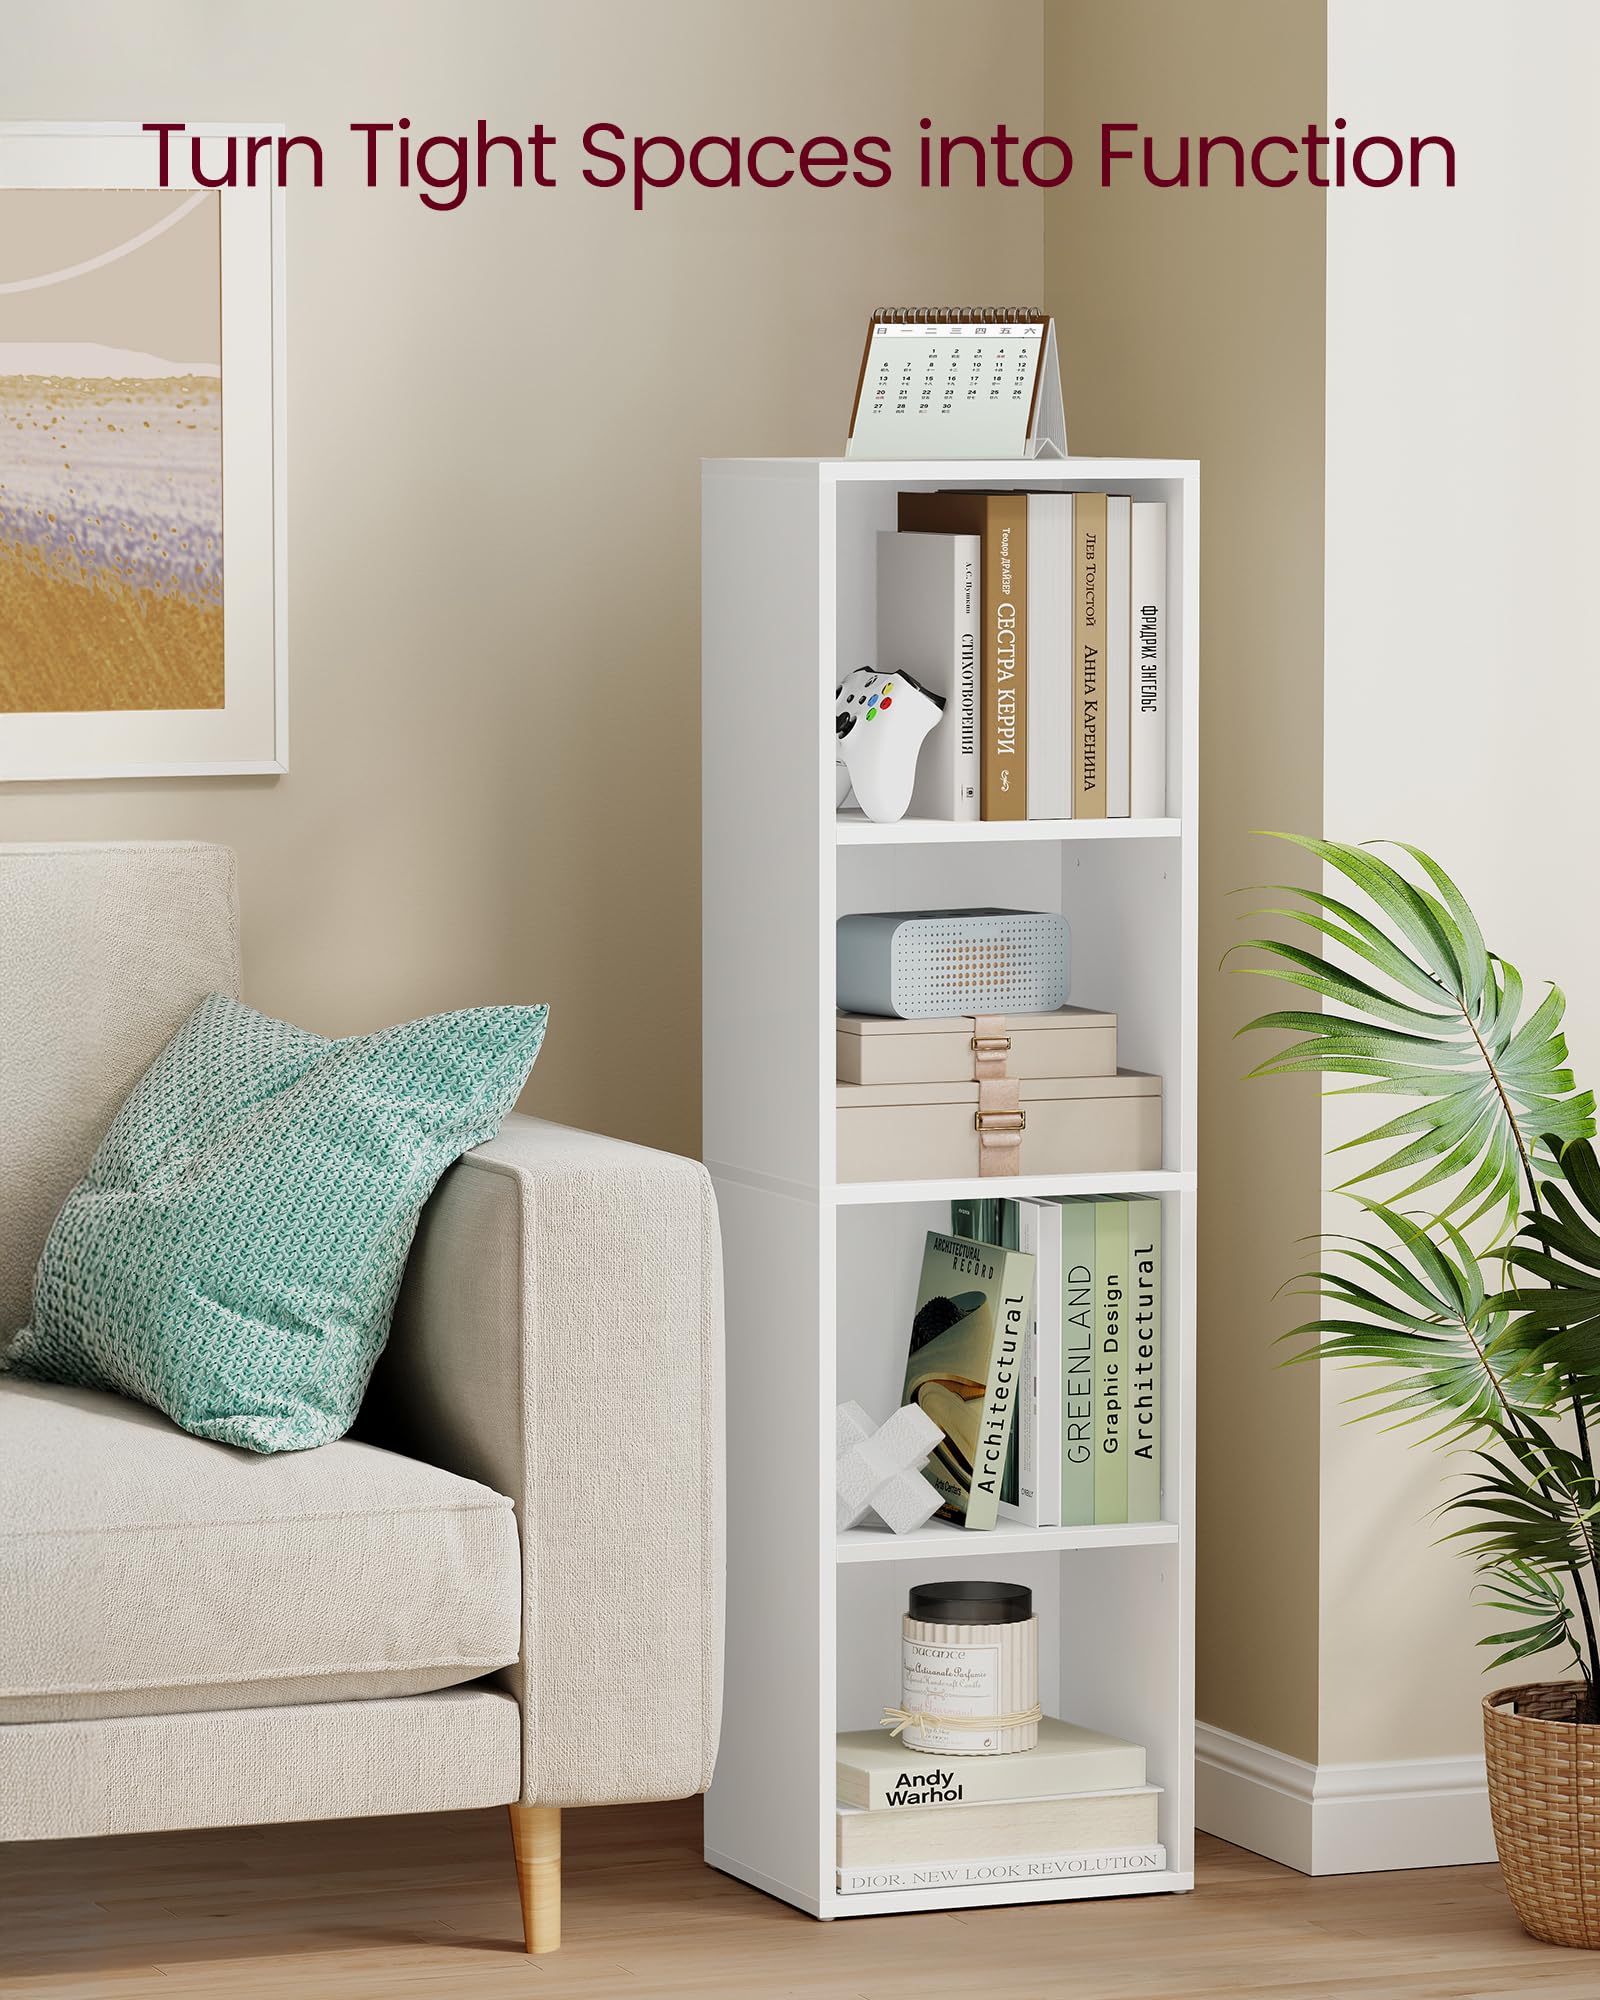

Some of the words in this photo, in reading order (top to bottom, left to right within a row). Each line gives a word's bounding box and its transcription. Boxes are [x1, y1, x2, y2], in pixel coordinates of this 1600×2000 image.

[1001, 558, 1012, 595] ДРАЙЗЕР
[998, 603, 1015, 682] СЕСТРА
[1140, 606, 1158, 658] ФРИДРИХ
[961, 633, 973, 754] СТИХОТВОРЕНИЯ
[1141, 665, 1156, 712] ЭНГЕЛЬС
[998, 689, 1015, 754] КЕРРИ
[934, 1237, 980, 1262] ARCHITECTURAL
[952, 1257, 995, 1280] RECORD
[1104, 1275, 1122, 1352] Design
[1068, 1266, 1091, 1463] GREENLAND
[1134, 1244, 1153, 1459] Architectural
[977, 1294, 1025, 1495] Architectural
[1103, 1364, 1121, 1453] Graphic
[886, 1785, 963, 1807] Warhol
[895, 1769, 955, 1789] Andy
[851, 1875, 906, 1890] DIOR.
[912, 1869, 960, 1885] NEW
[964, 1863, 1022, 1881] LOOK
[1027, 1854, 1159, 1876] REVOLUTION
